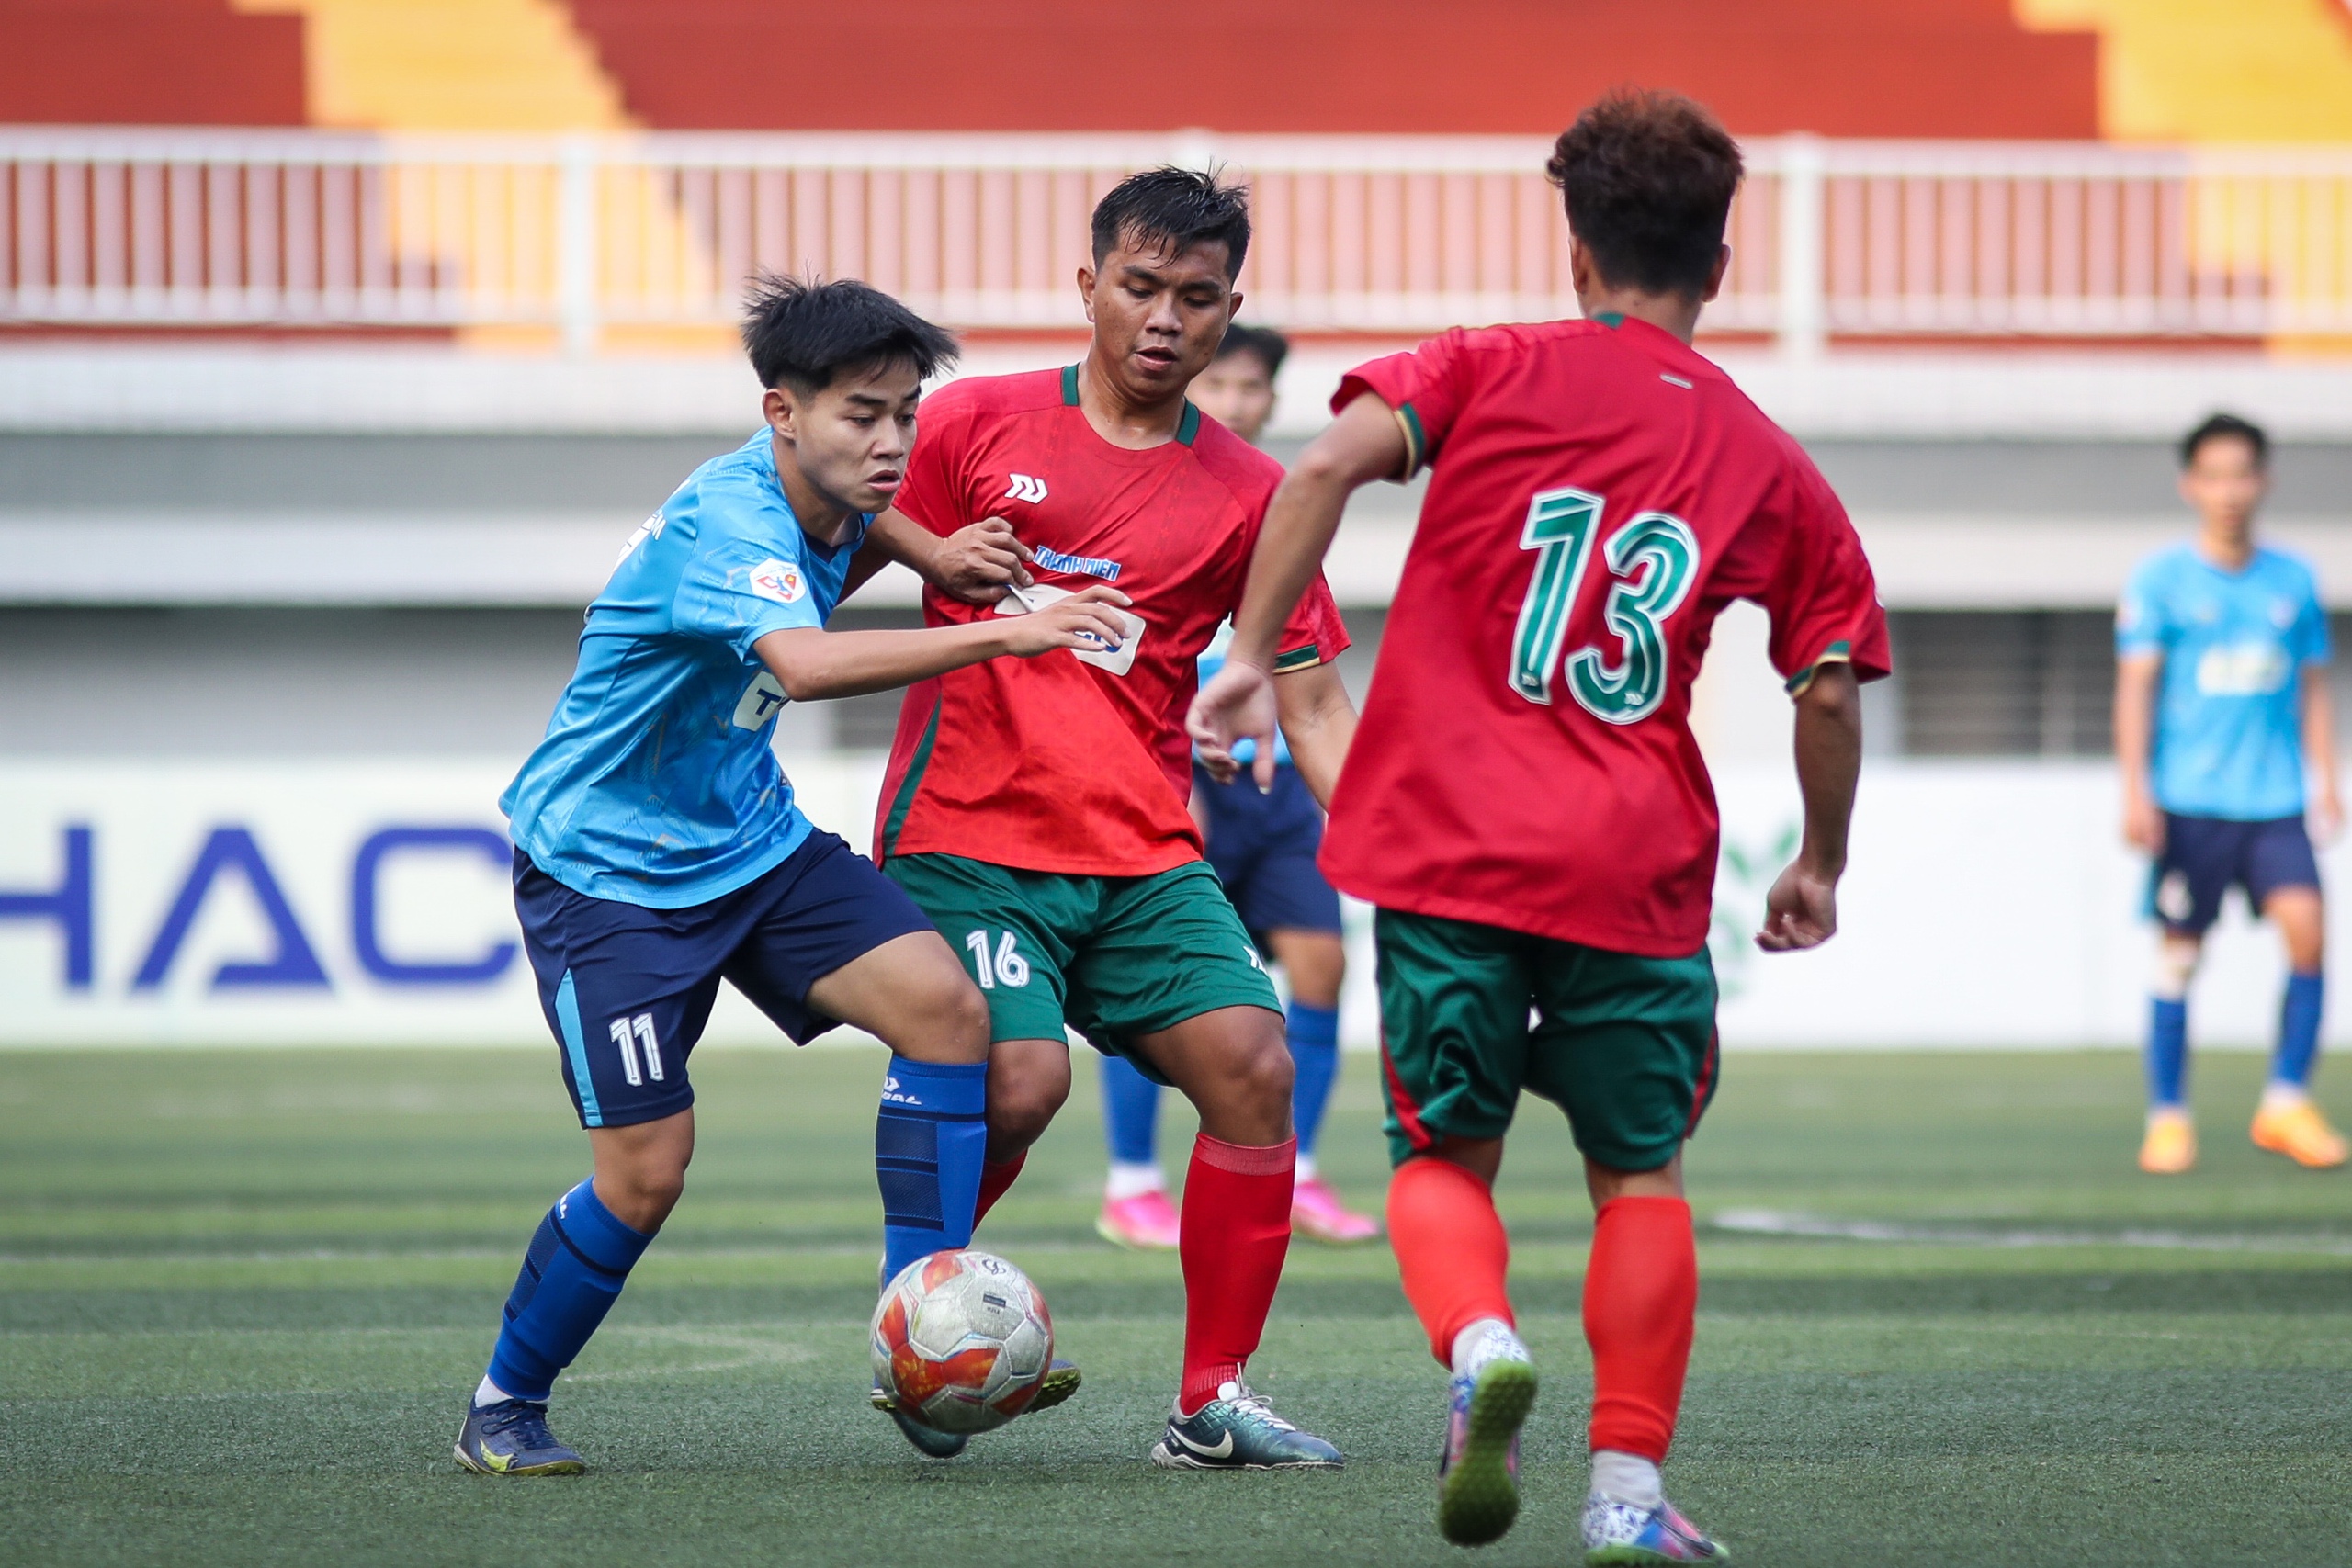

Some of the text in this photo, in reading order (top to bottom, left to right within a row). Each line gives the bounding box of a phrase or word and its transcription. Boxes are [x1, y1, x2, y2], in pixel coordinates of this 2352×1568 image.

[1509, 487, 1700, 725] 13
[756, 688, 786, 716] T
[966, 930, 1030, 988] 16
[609, 1013, 664, 1087] 11
